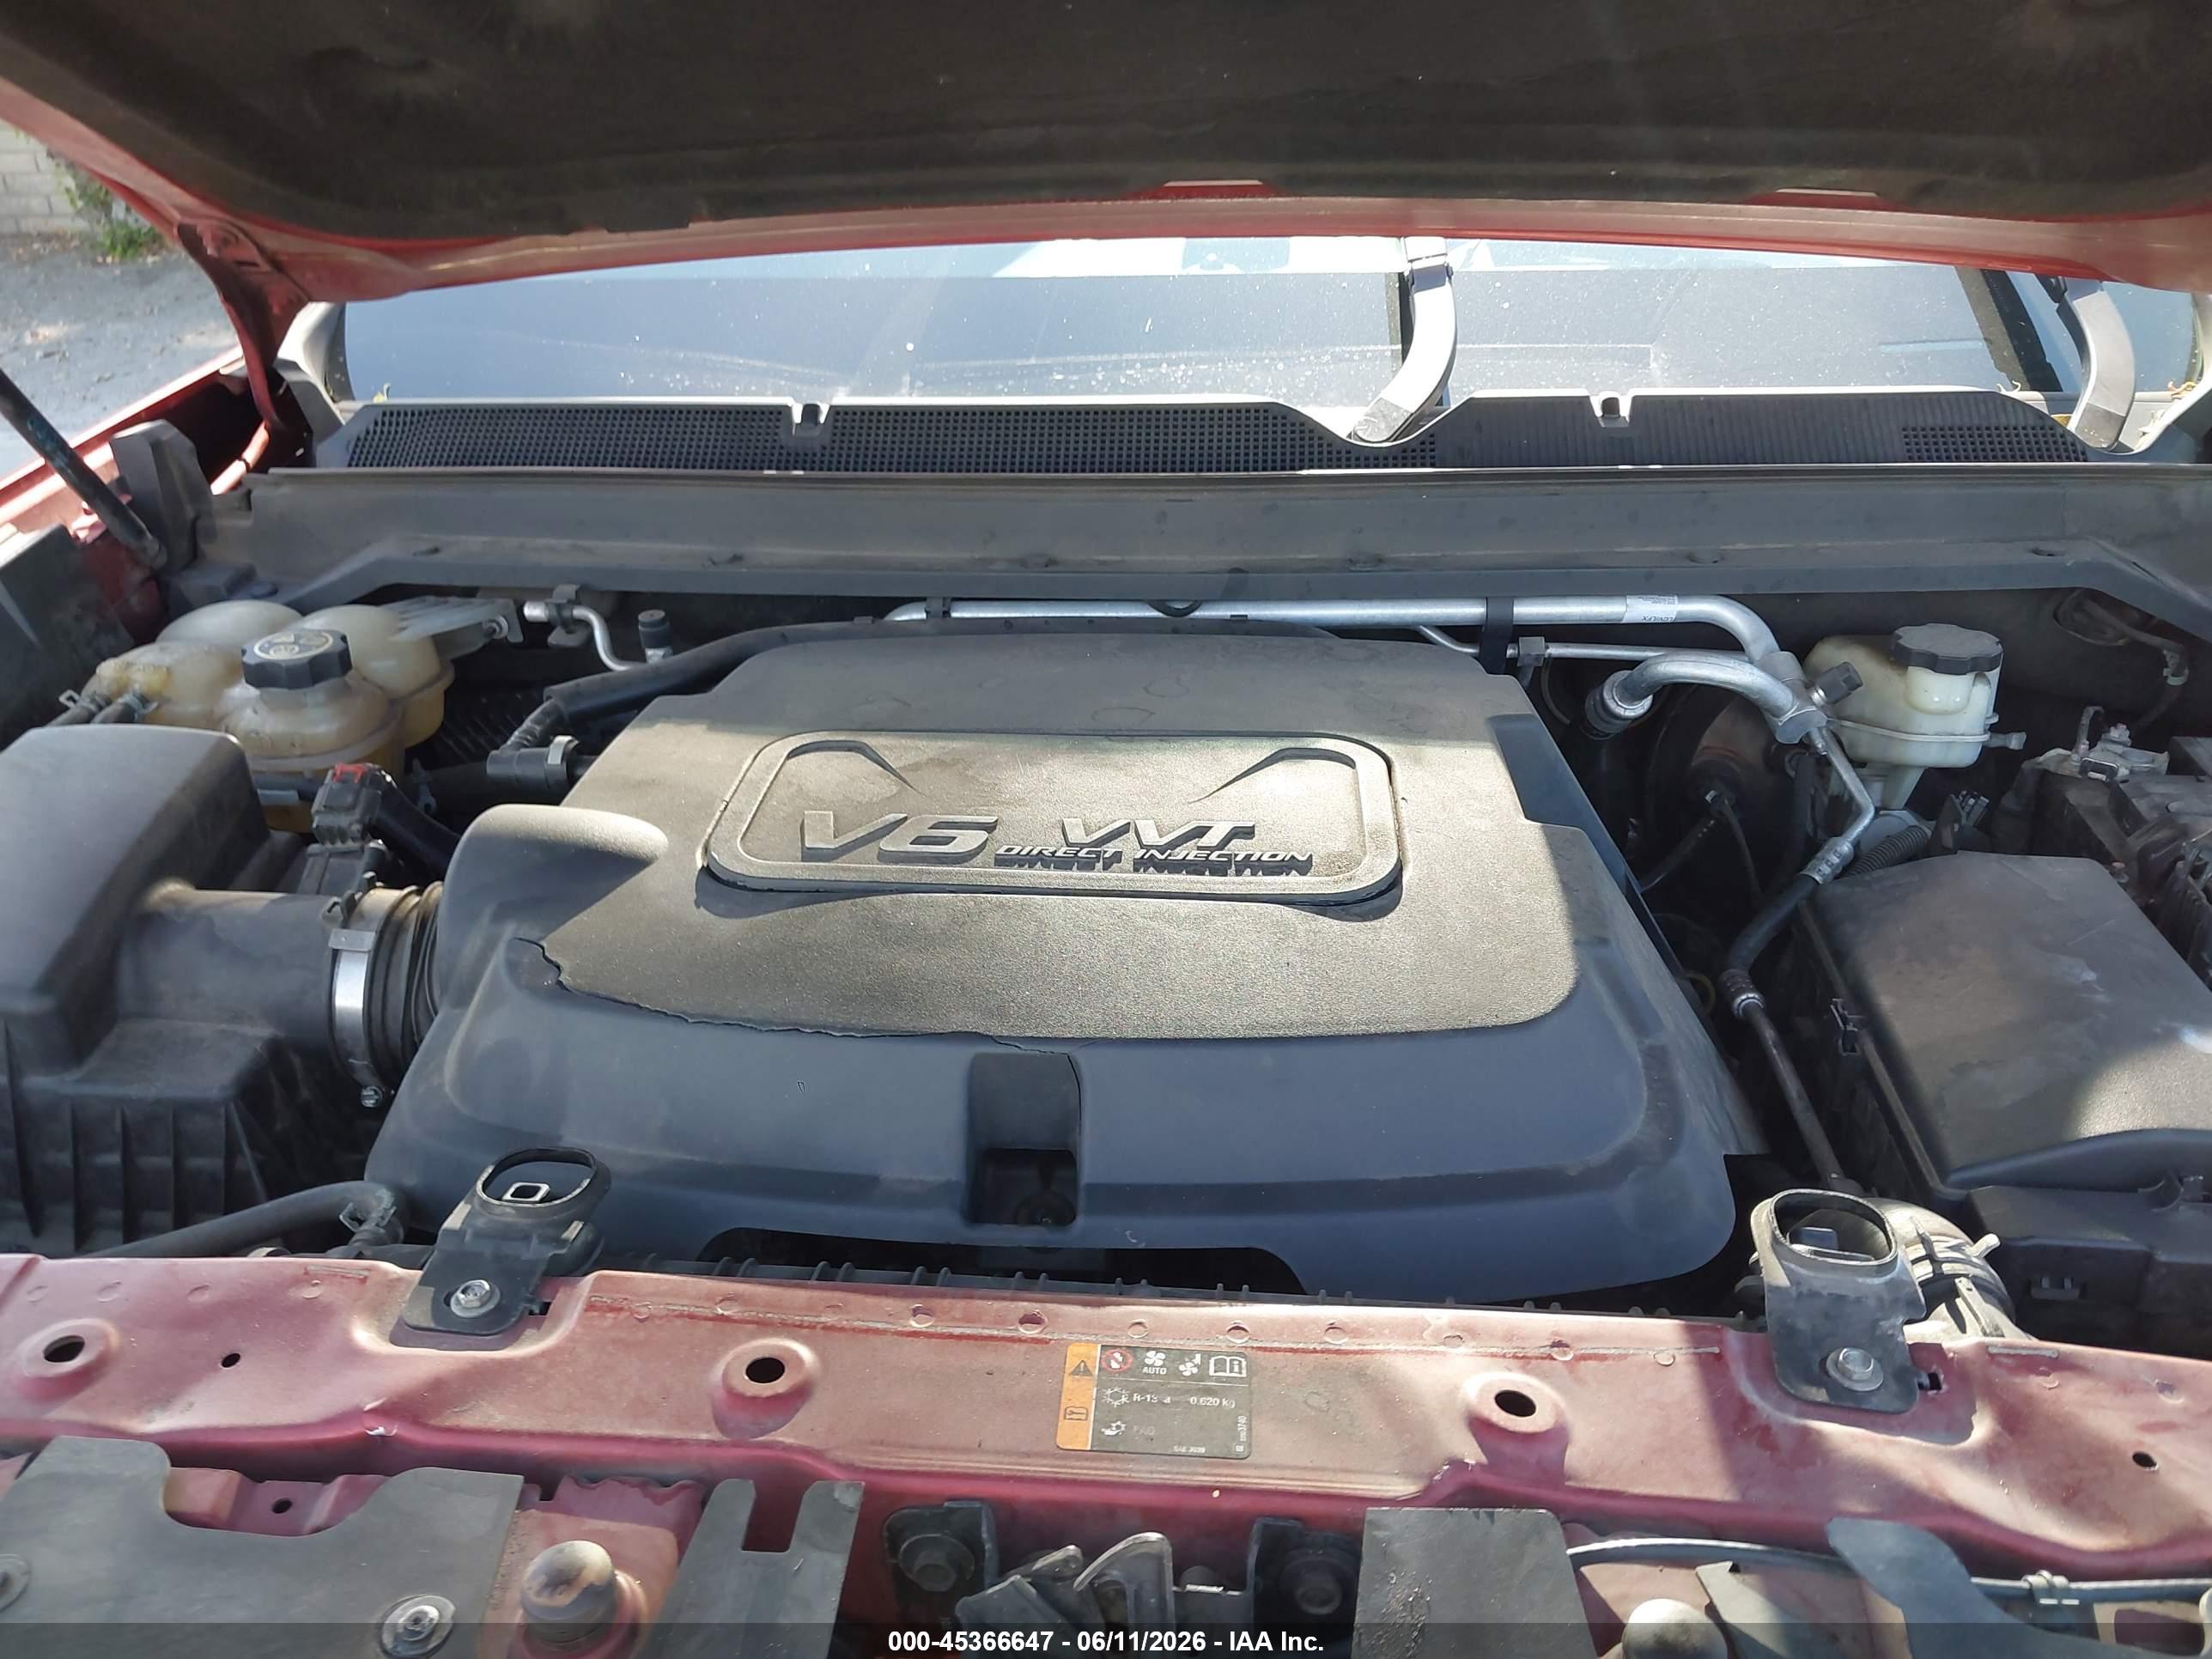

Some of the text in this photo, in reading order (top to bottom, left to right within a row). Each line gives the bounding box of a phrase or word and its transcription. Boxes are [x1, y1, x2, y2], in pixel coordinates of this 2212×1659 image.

[802, 811, 1255, 860] V6 VVT
[994, 845, 1313, 868] DIRECT INJECTION
[1142, 1366, 1167, 1375] AUTO
[1189, 1396, 1219, 1407] 0.620
[1222, 1398, 1236, 1409] kg
